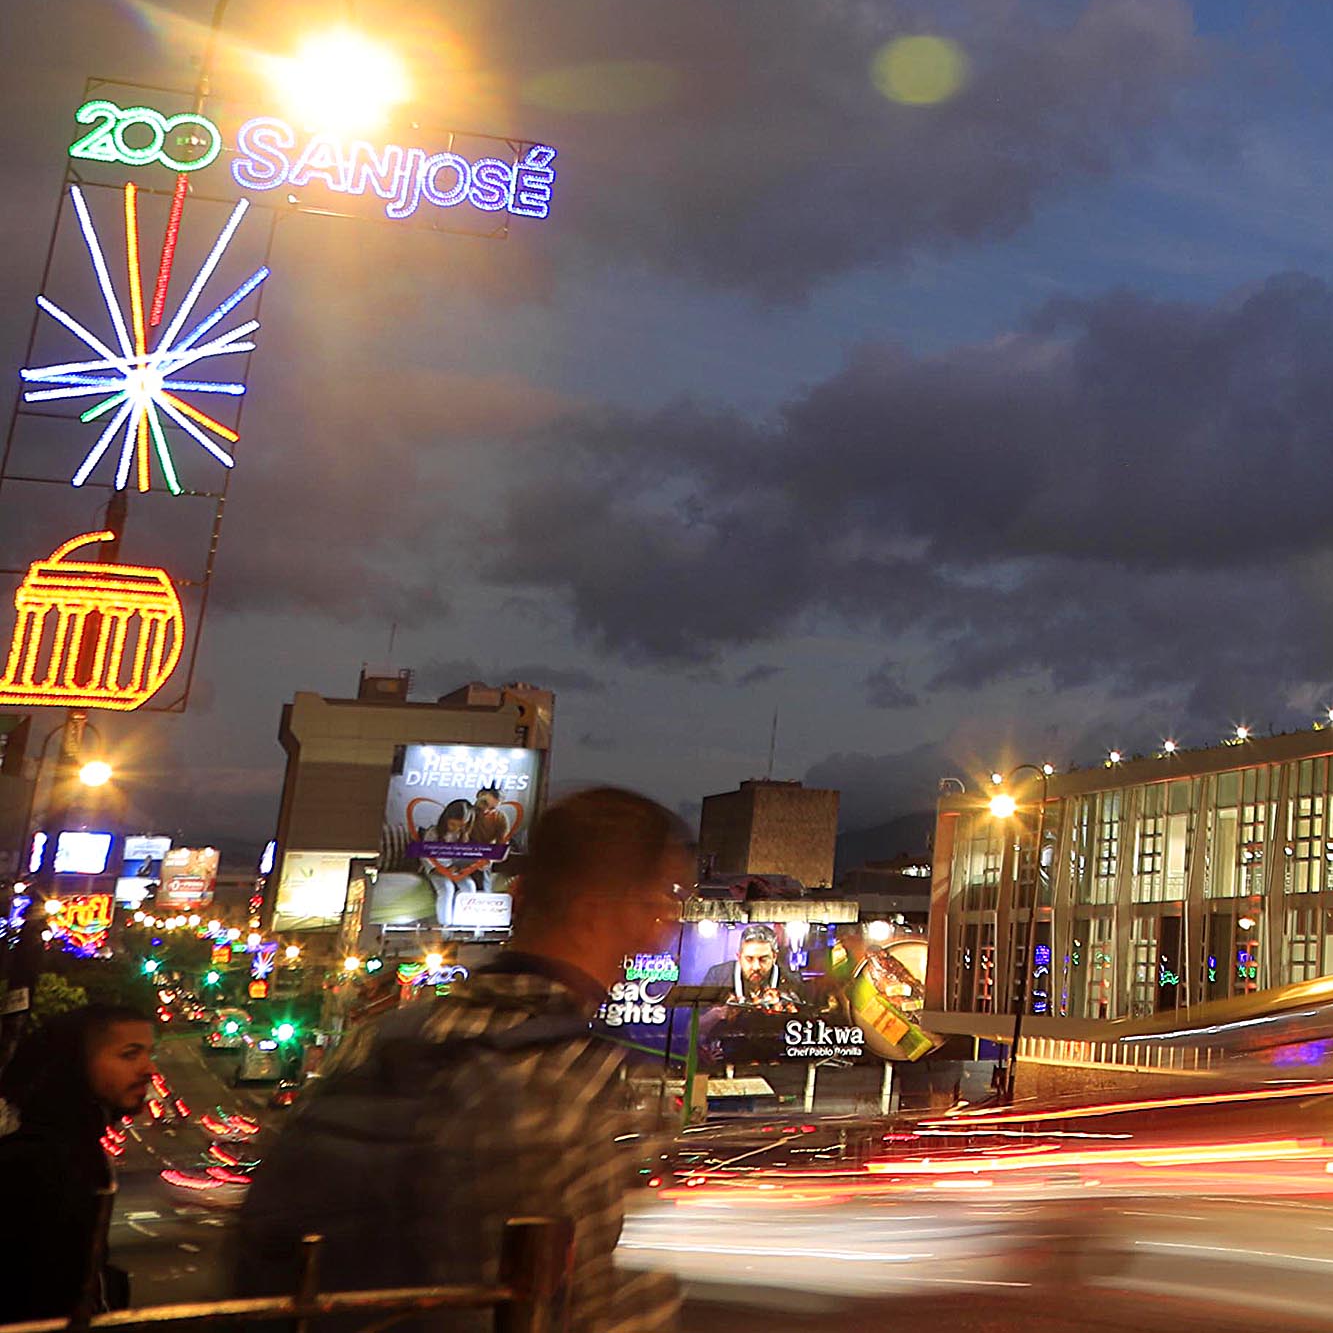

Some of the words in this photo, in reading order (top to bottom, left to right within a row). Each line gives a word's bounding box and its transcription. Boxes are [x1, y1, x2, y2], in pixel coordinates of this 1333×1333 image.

[69, 100, 221, 171] 200
[423, 754, 510, 773] HECHOS
[405, 770, 529, 790] DIFERENTES
[784, 1019, 865, 1045] Sikwa
